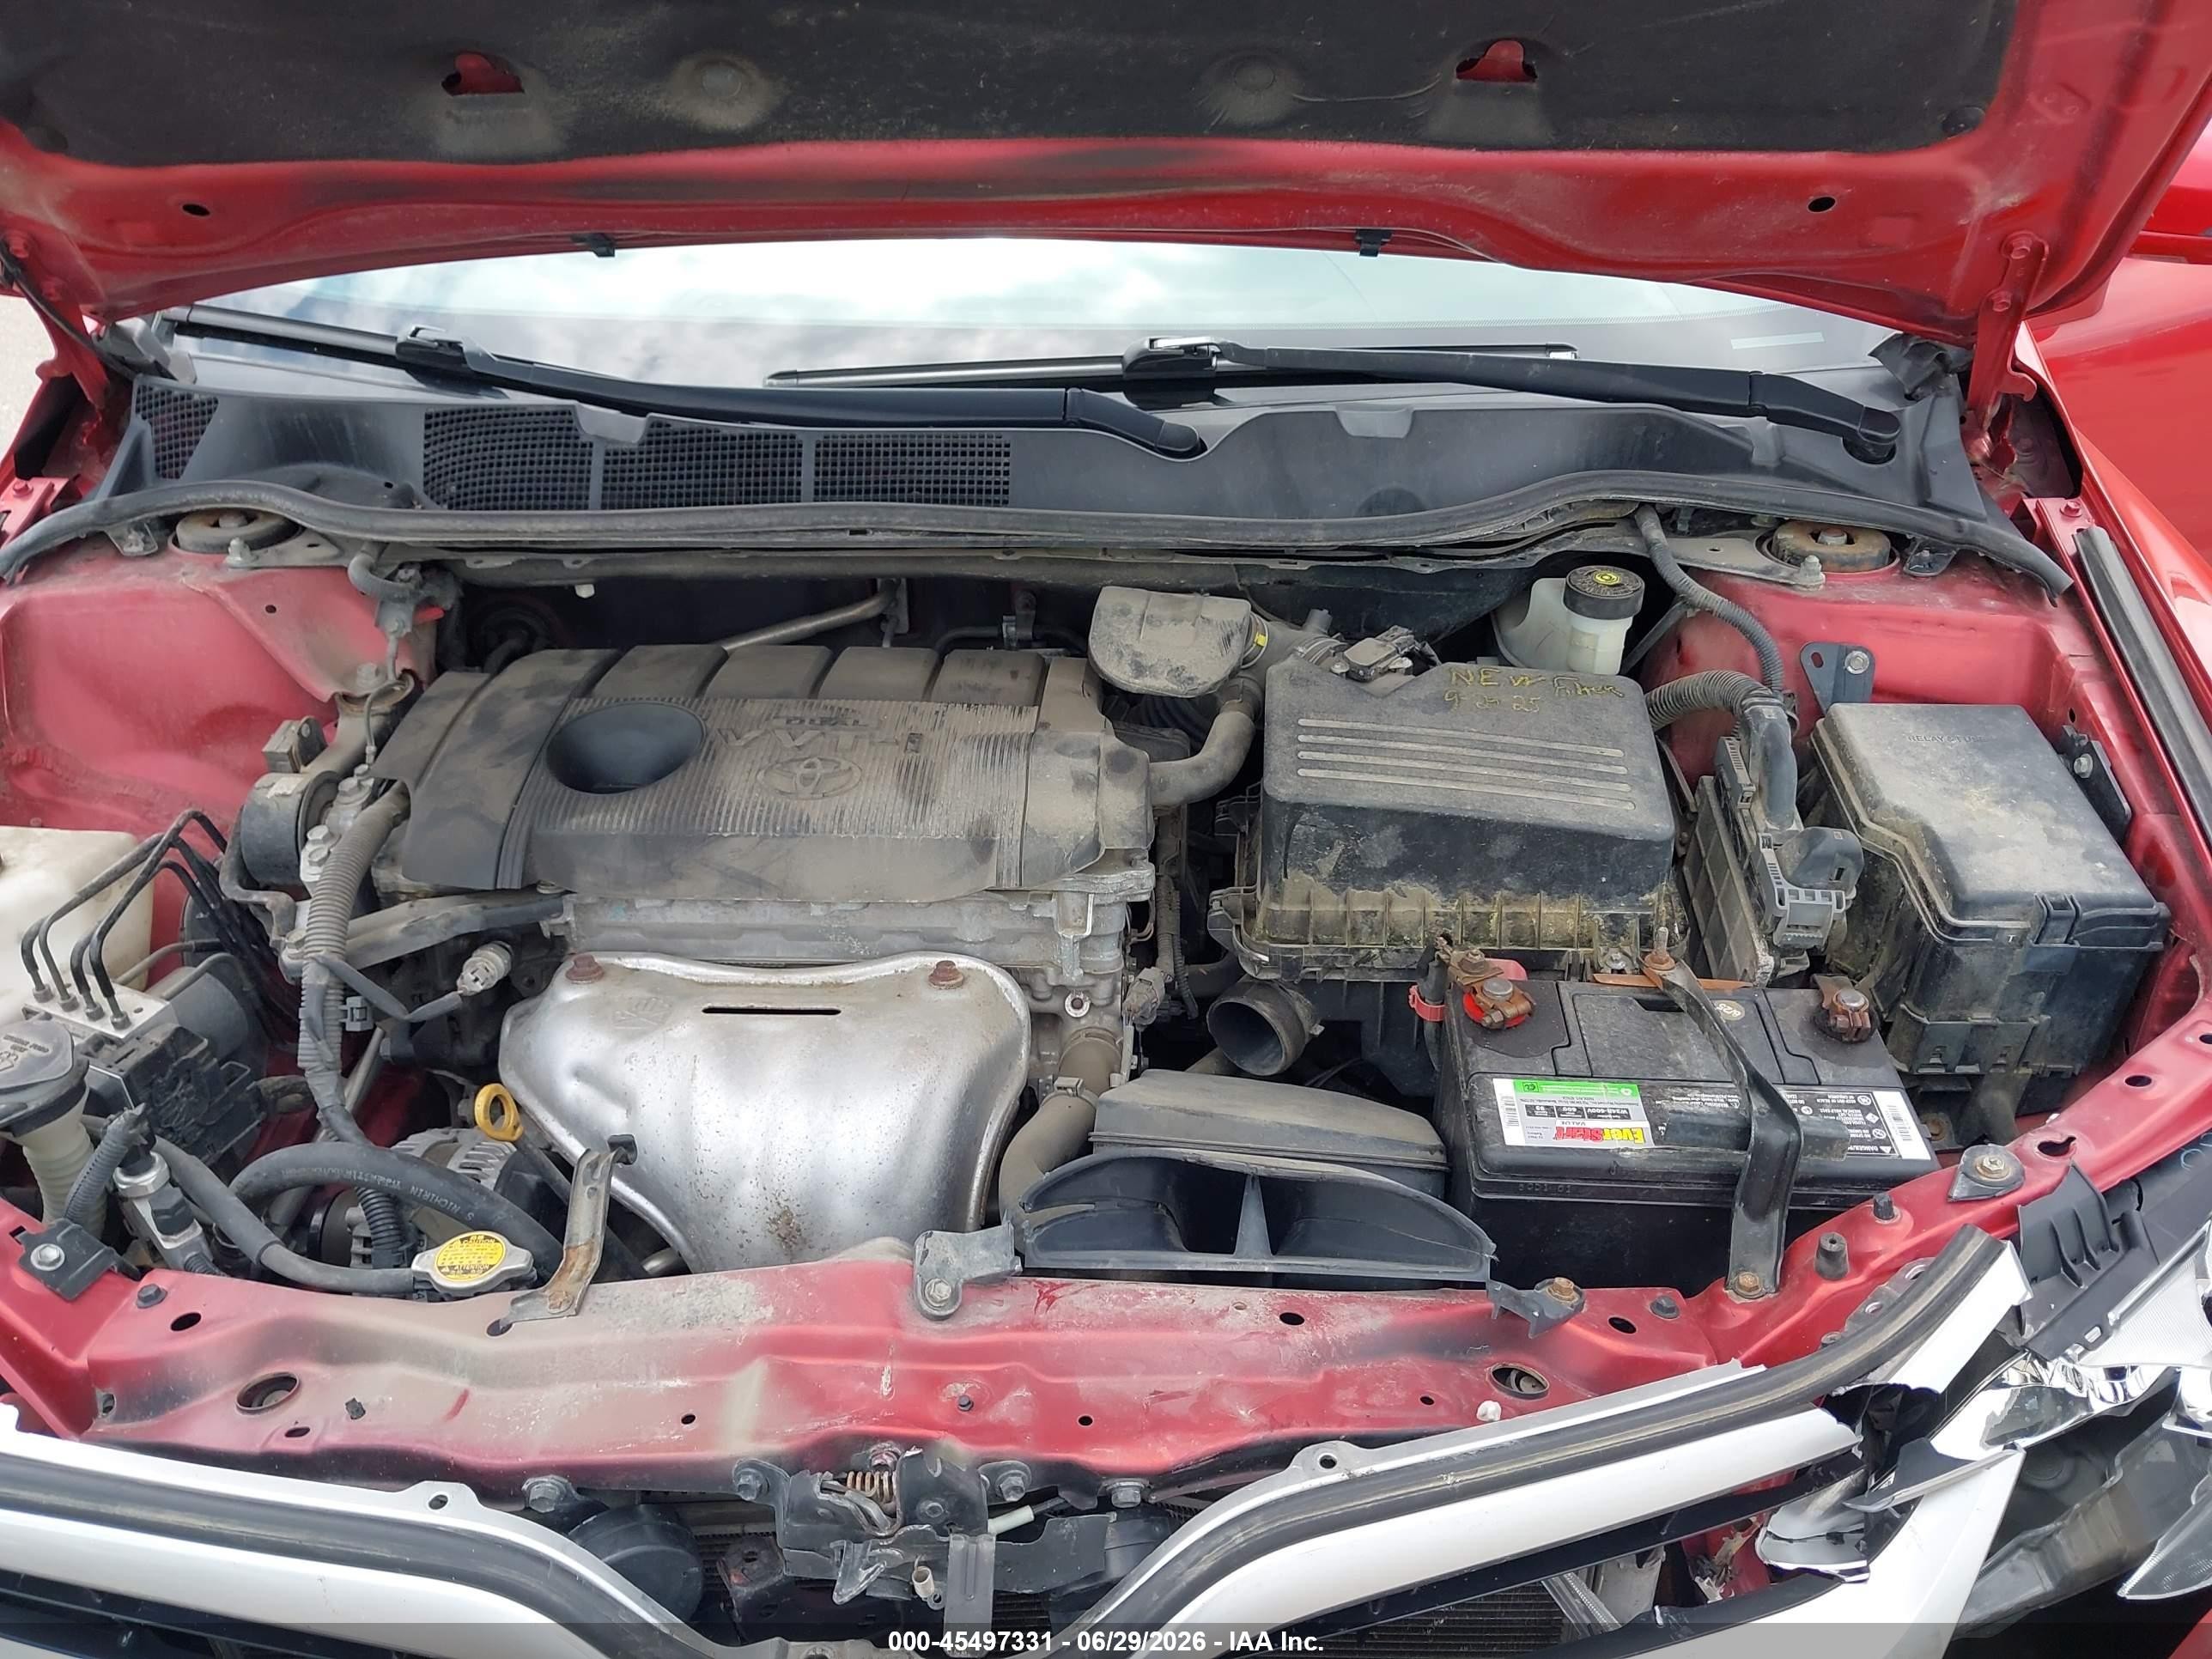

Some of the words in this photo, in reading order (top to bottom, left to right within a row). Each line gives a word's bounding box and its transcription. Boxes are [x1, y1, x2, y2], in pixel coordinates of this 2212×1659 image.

[1449, 666, 1547, 688] NEW
[1907, 735, 1945, 744] RELAY
[1956, 735, 1988, 744] FUSE
[1555, 1127, 1646, 1145] EverStart
[410, 1185, 462, 1215] NICHIRIN
